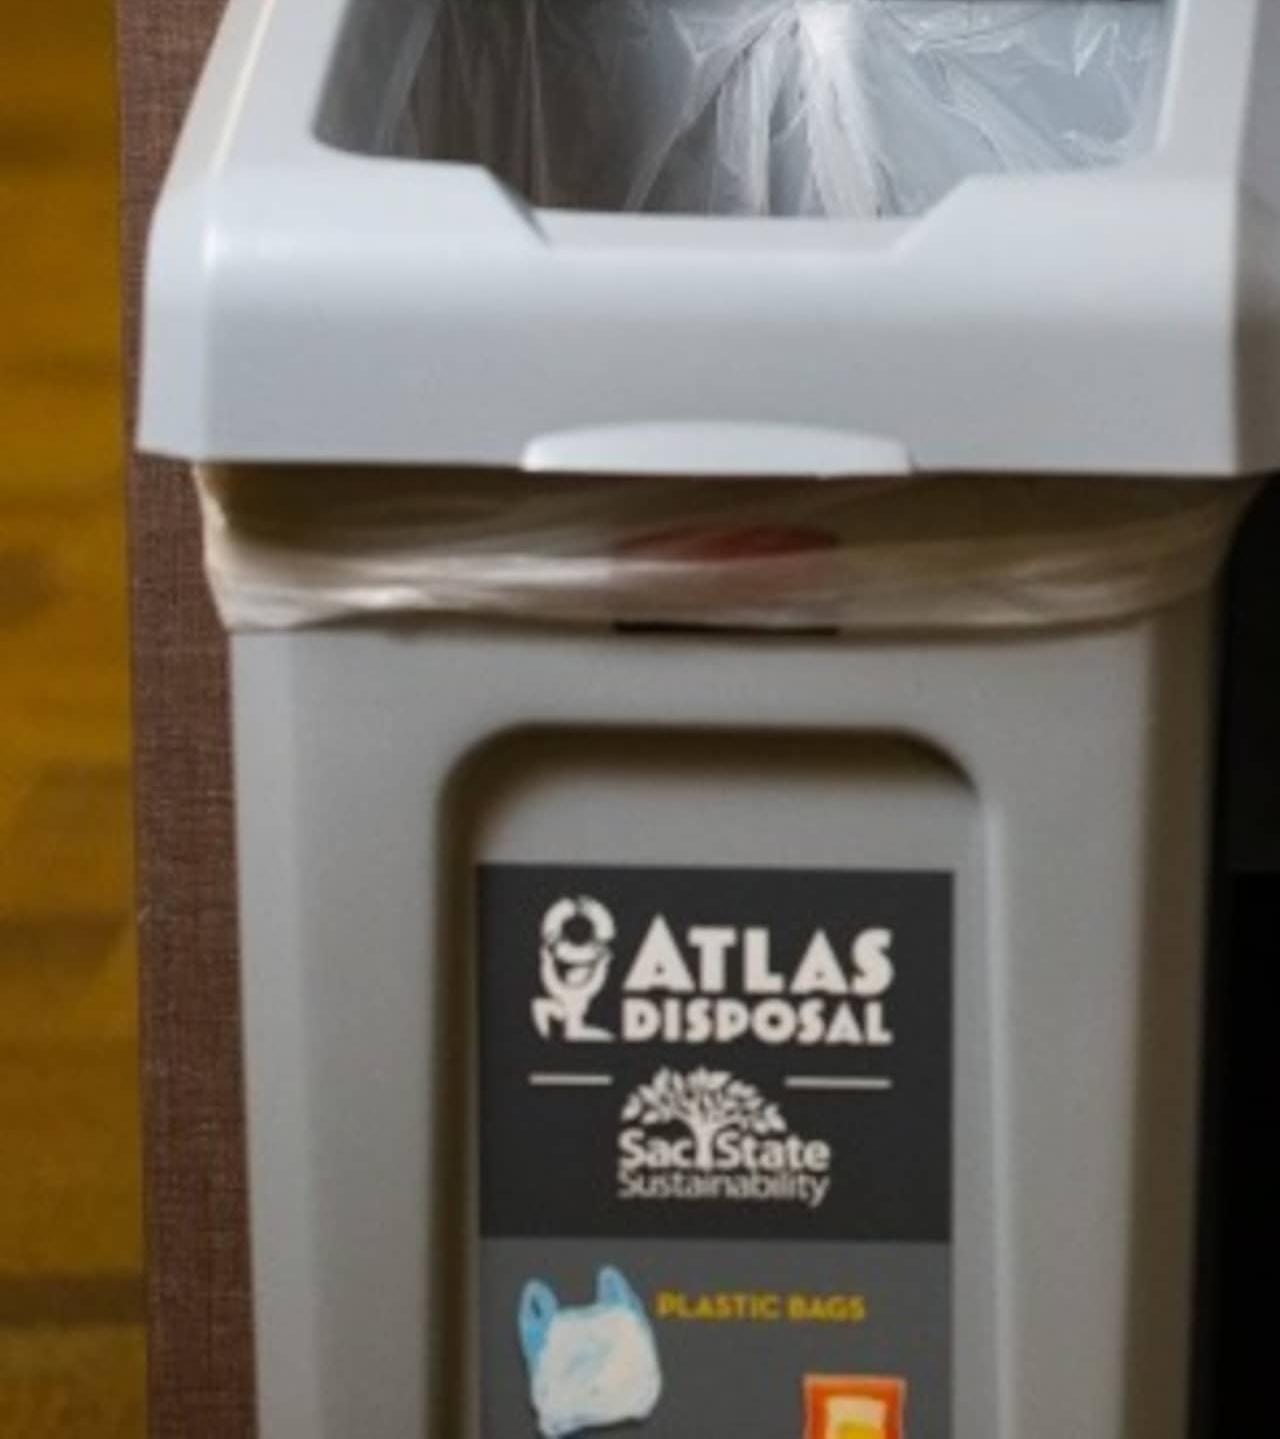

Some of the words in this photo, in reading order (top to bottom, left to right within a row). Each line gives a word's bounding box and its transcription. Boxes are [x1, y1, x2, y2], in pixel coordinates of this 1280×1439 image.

[623, 913, 894, 997] ATLAS
[621, 998, 894, 1045] DISPOSAL
[618, 1128, 692, 1170] Sac
[717, 1129, 831, 1171] State
[618, 1168, 831, 1207] Sustainability
[656, 1291, 781, 1320] PLASTIC
[788, 1295, 866, 1322] BAGS
